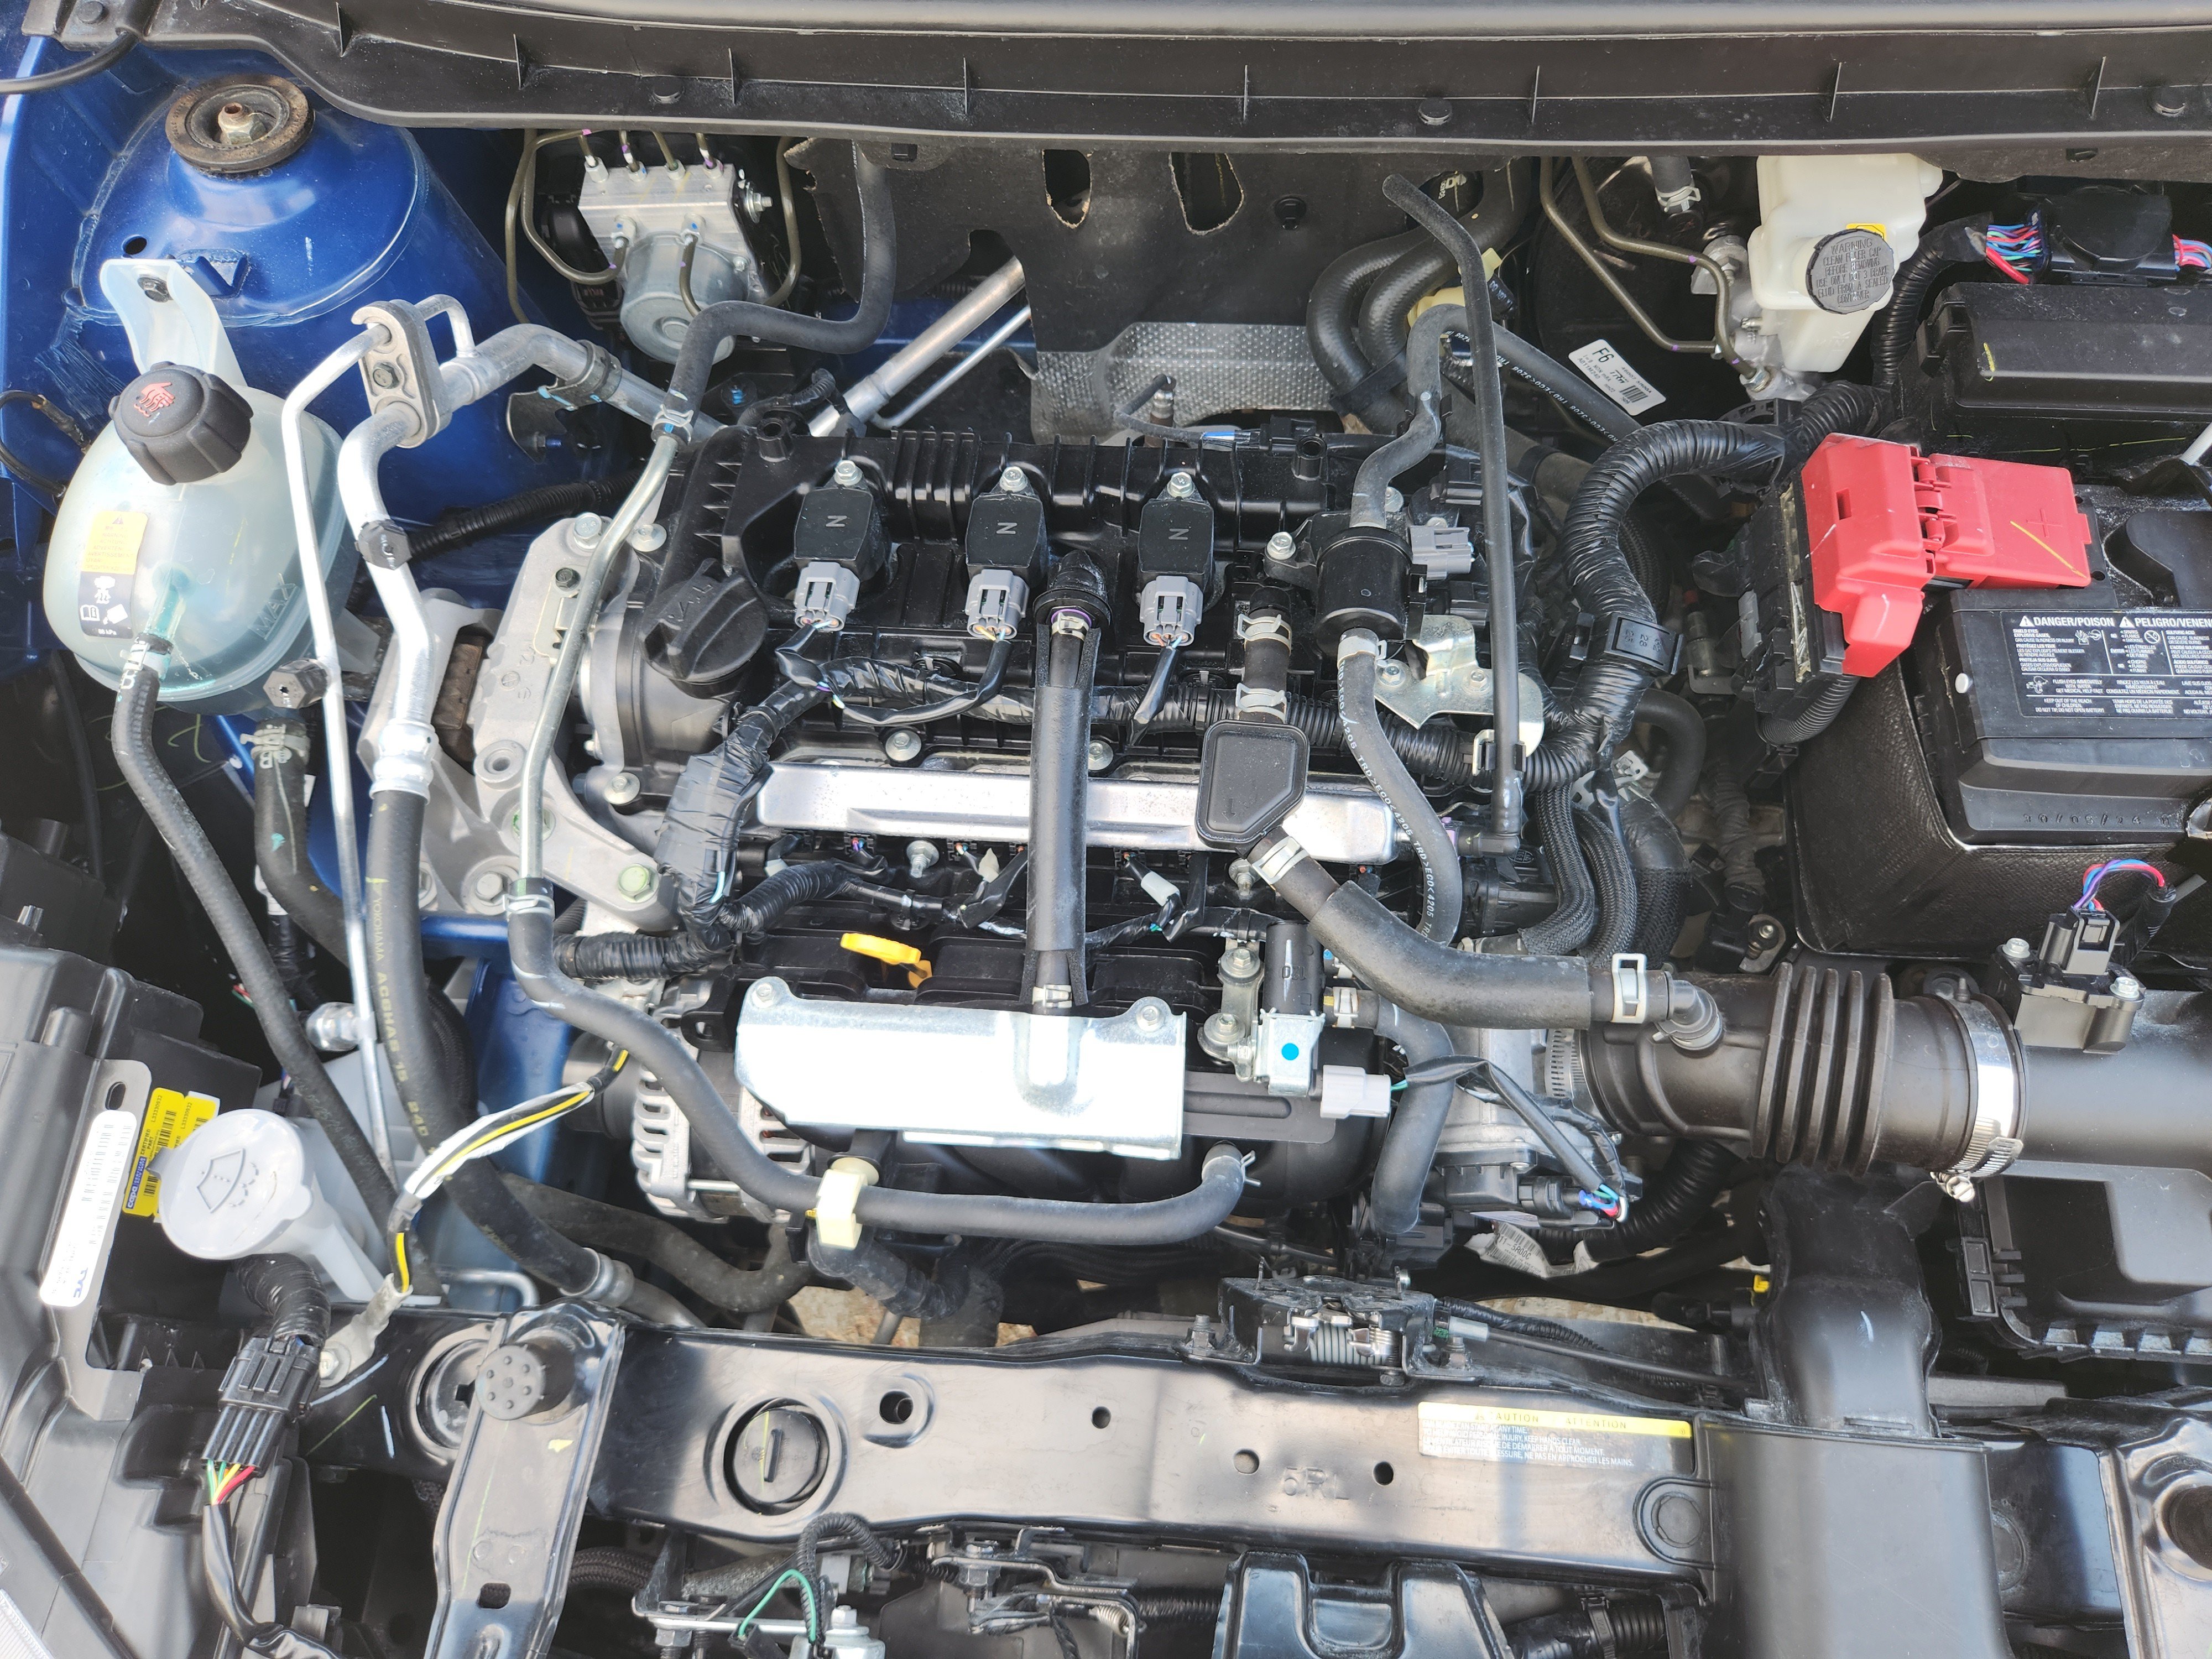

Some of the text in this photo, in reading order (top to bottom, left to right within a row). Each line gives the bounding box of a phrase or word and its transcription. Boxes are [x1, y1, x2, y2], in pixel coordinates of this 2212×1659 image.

[1831, 238, 1872, 254] WARNING
[1823, 248, 1881, 267] CLEAN FILLER CAP
[1825, 258, 1880, 276] BEFORE REMOVING
[1817, 278, 1827, 288] USE
[1831, 274, 1845, 285] ONLY
[1871, 265, 1888, 276] BRAKE
[1838, 283, 1854, 293] FROM
[1866, 277, 1887, 288] SEALED
[1592, 348, 1614, 362] F6
[2033, 617, 2115, 627] DANGER/POISON
[373, 897, 385, 962] YOKOHAMA
[140, 1129, 150, 1155] CERTIFIED
[127, 1186, 138, 1208] capa
[1566, 1417, 1626, 1429] ATTENTION
[1525, 1451, 1533, 1459] NE
[1535, 1452, 1547, 1460] PAS
[1558, 1454, 1597, 1464] APPROCHER
[1598, 1456, 1610, 1464] LES
[1556, 1446, 1572, 1454] TOUT
